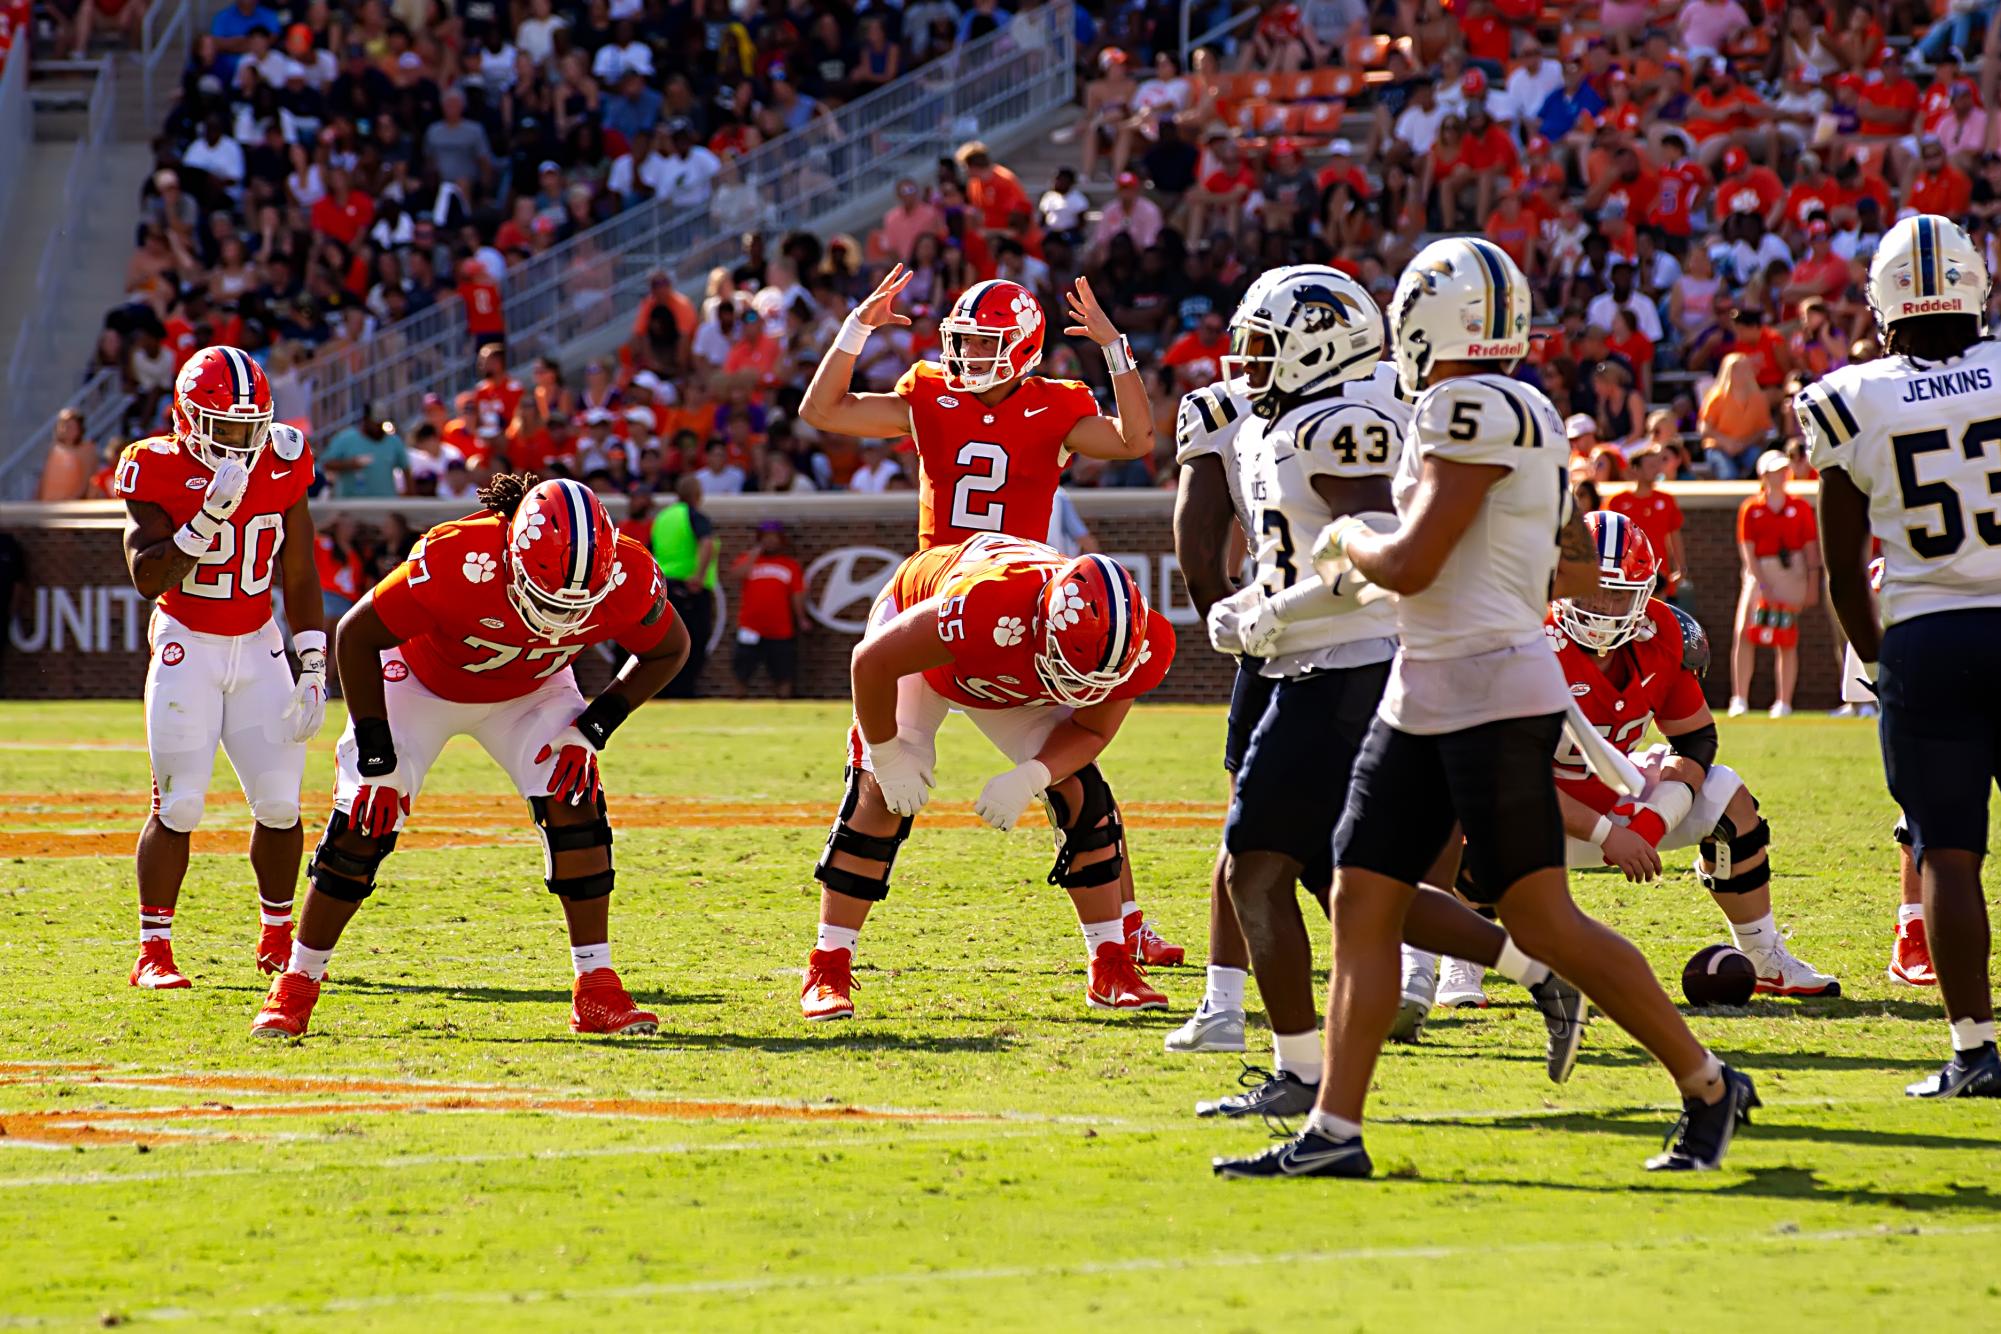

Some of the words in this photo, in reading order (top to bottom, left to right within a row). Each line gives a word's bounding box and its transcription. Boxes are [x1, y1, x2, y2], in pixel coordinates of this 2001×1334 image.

[1903, 298, 1962, 315] Riddell
[1467, 342, 1525, 358] Riddell
[1903, 368, 1993, 403] JENKINS
[1449, 401, 1482, 441] 5
[1331, 425, 1389, 464] 43
[951, 440, 1008, 532] 2
[1889, 417, 2001, 563] 53
[181, 513, 285, 600] 20
[1254, 507, 1298, 598] 3
[938, 595, 966, 643] 55
[461, 635, 585, 680] 77
